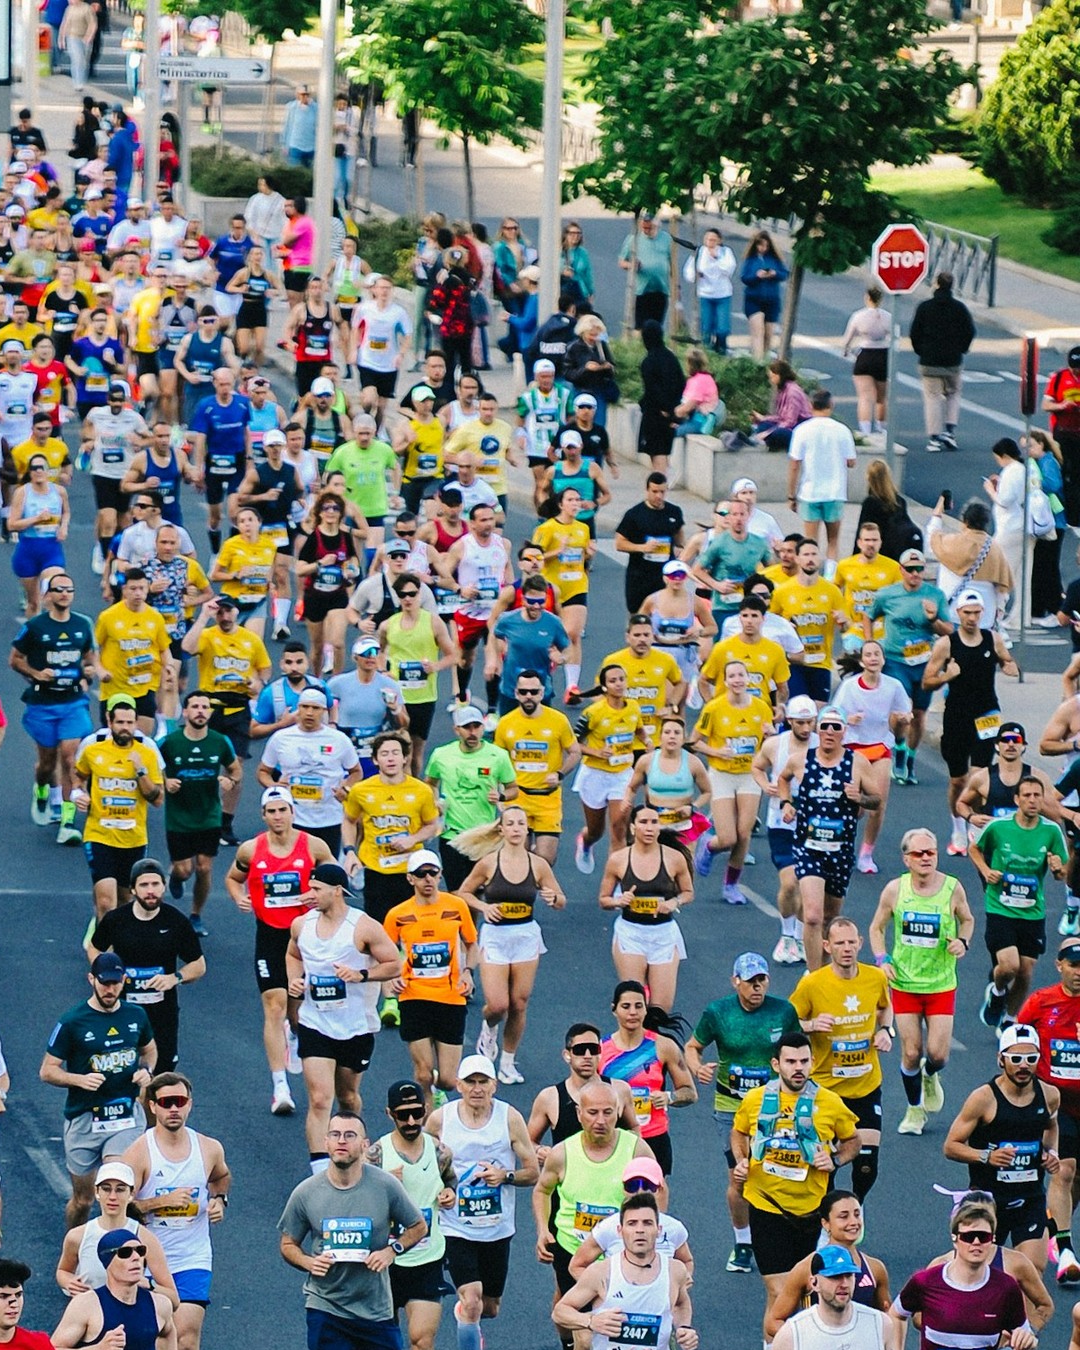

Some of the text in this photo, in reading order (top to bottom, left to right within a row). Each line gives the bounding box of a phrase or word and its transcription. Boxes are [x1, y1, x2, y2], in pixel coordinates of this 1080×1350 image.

[879, 251, 924, 269] STOP
[91, 1050, 137, 1072] MADRID
[103, 1104, 124, 1117] 1063
[469, 1199, 492, 1212] 3495
[340, 1221, 366, 1229] ZURICH
[332, 1231, 363, 1245] 10573
[623, 1326, 648, 1340] 2447
